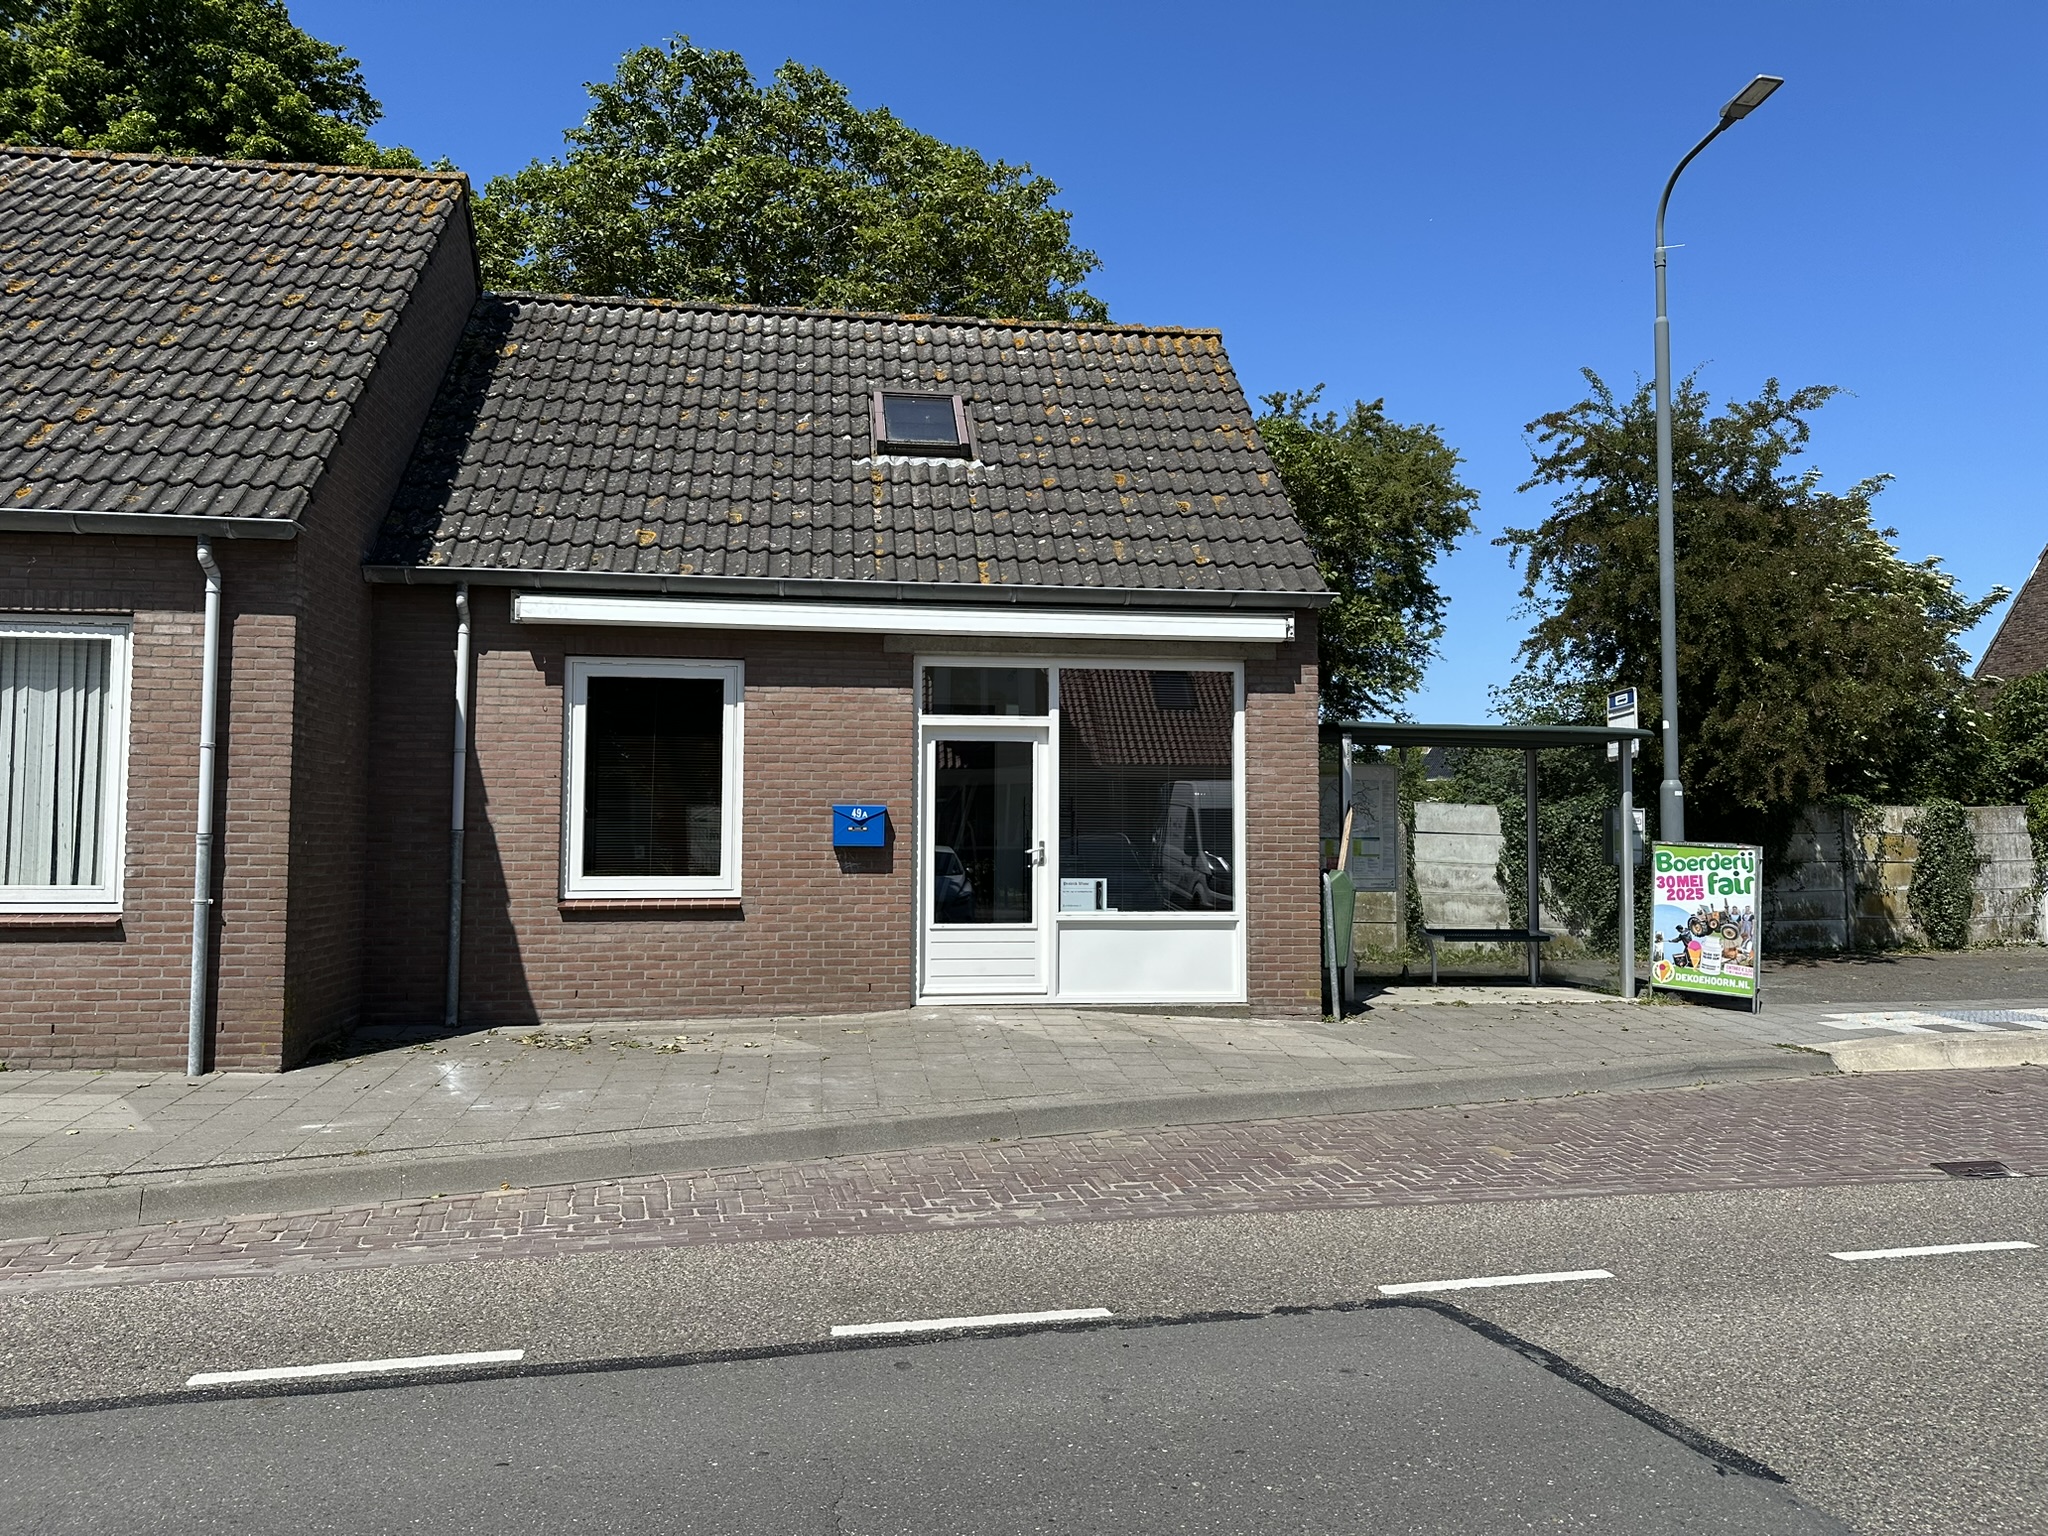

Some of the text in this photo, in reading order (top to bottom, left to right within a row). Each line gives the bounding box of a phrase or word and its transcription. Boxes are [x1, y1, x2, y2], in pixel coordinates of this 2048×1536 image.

[1655, 852, 1755, 873] Boerderij
[1656, 875, 1704, 889] 30 MEI
[1707, 872, 1755, 895] fair
[1666, 888, 1705, 901] 2025
[1675, 972, 1751, 990] DEKOEHOORN.NL
